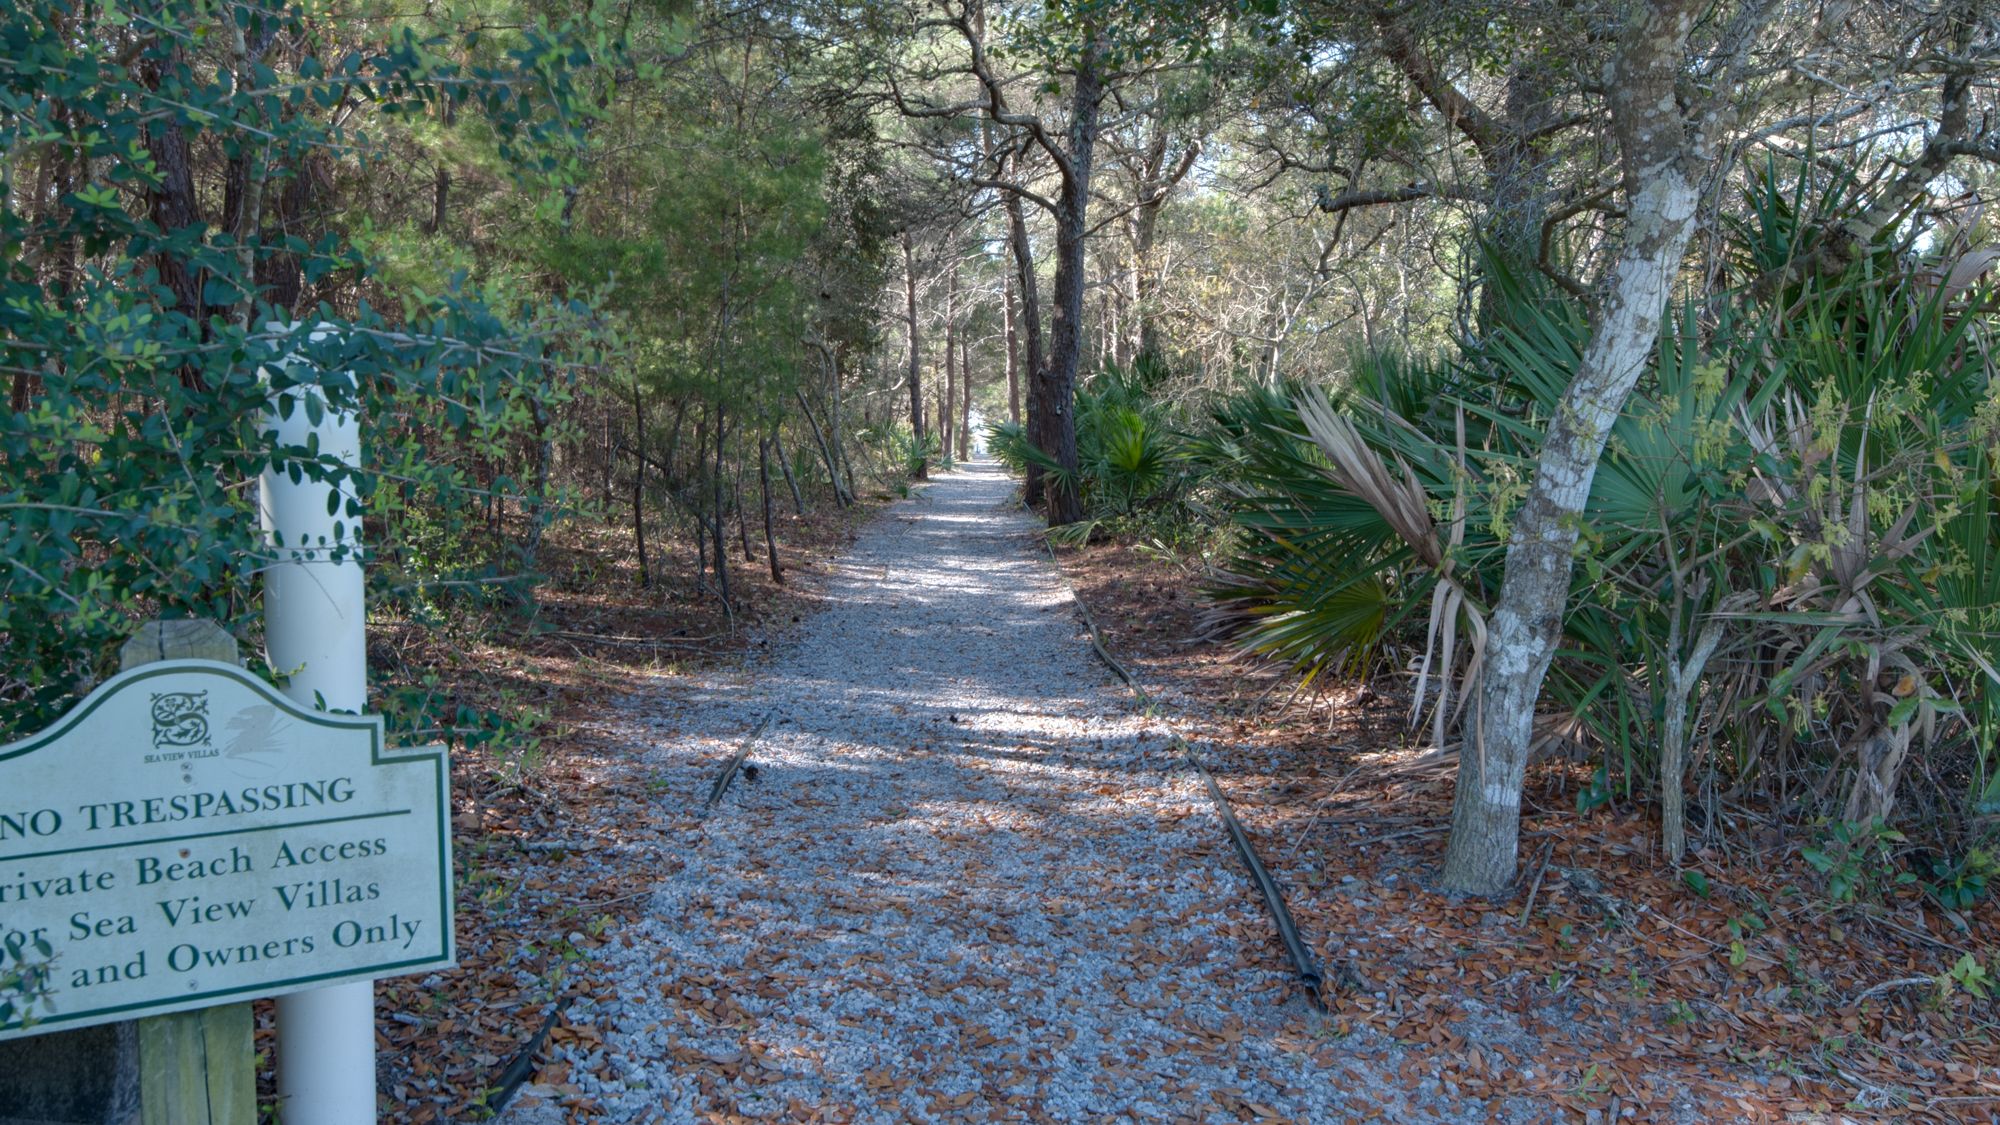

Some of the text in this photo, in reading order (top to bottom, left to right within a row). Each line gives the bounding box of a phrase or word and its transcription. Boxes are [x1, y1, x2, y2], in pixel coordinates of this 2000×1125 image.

[144, 749, 220, 763] SEA VIEW VILLAS
[0, 778, 355, 840] NO TRESPASSING
[0, 837, 387, 902] rivate Beach Access
[0, 879, 381, 951] or Sea View Villas
[71, 951, 148, 988] and
[167, 936, 314, 973] Owners
[332, 913, 422, 949] Only
